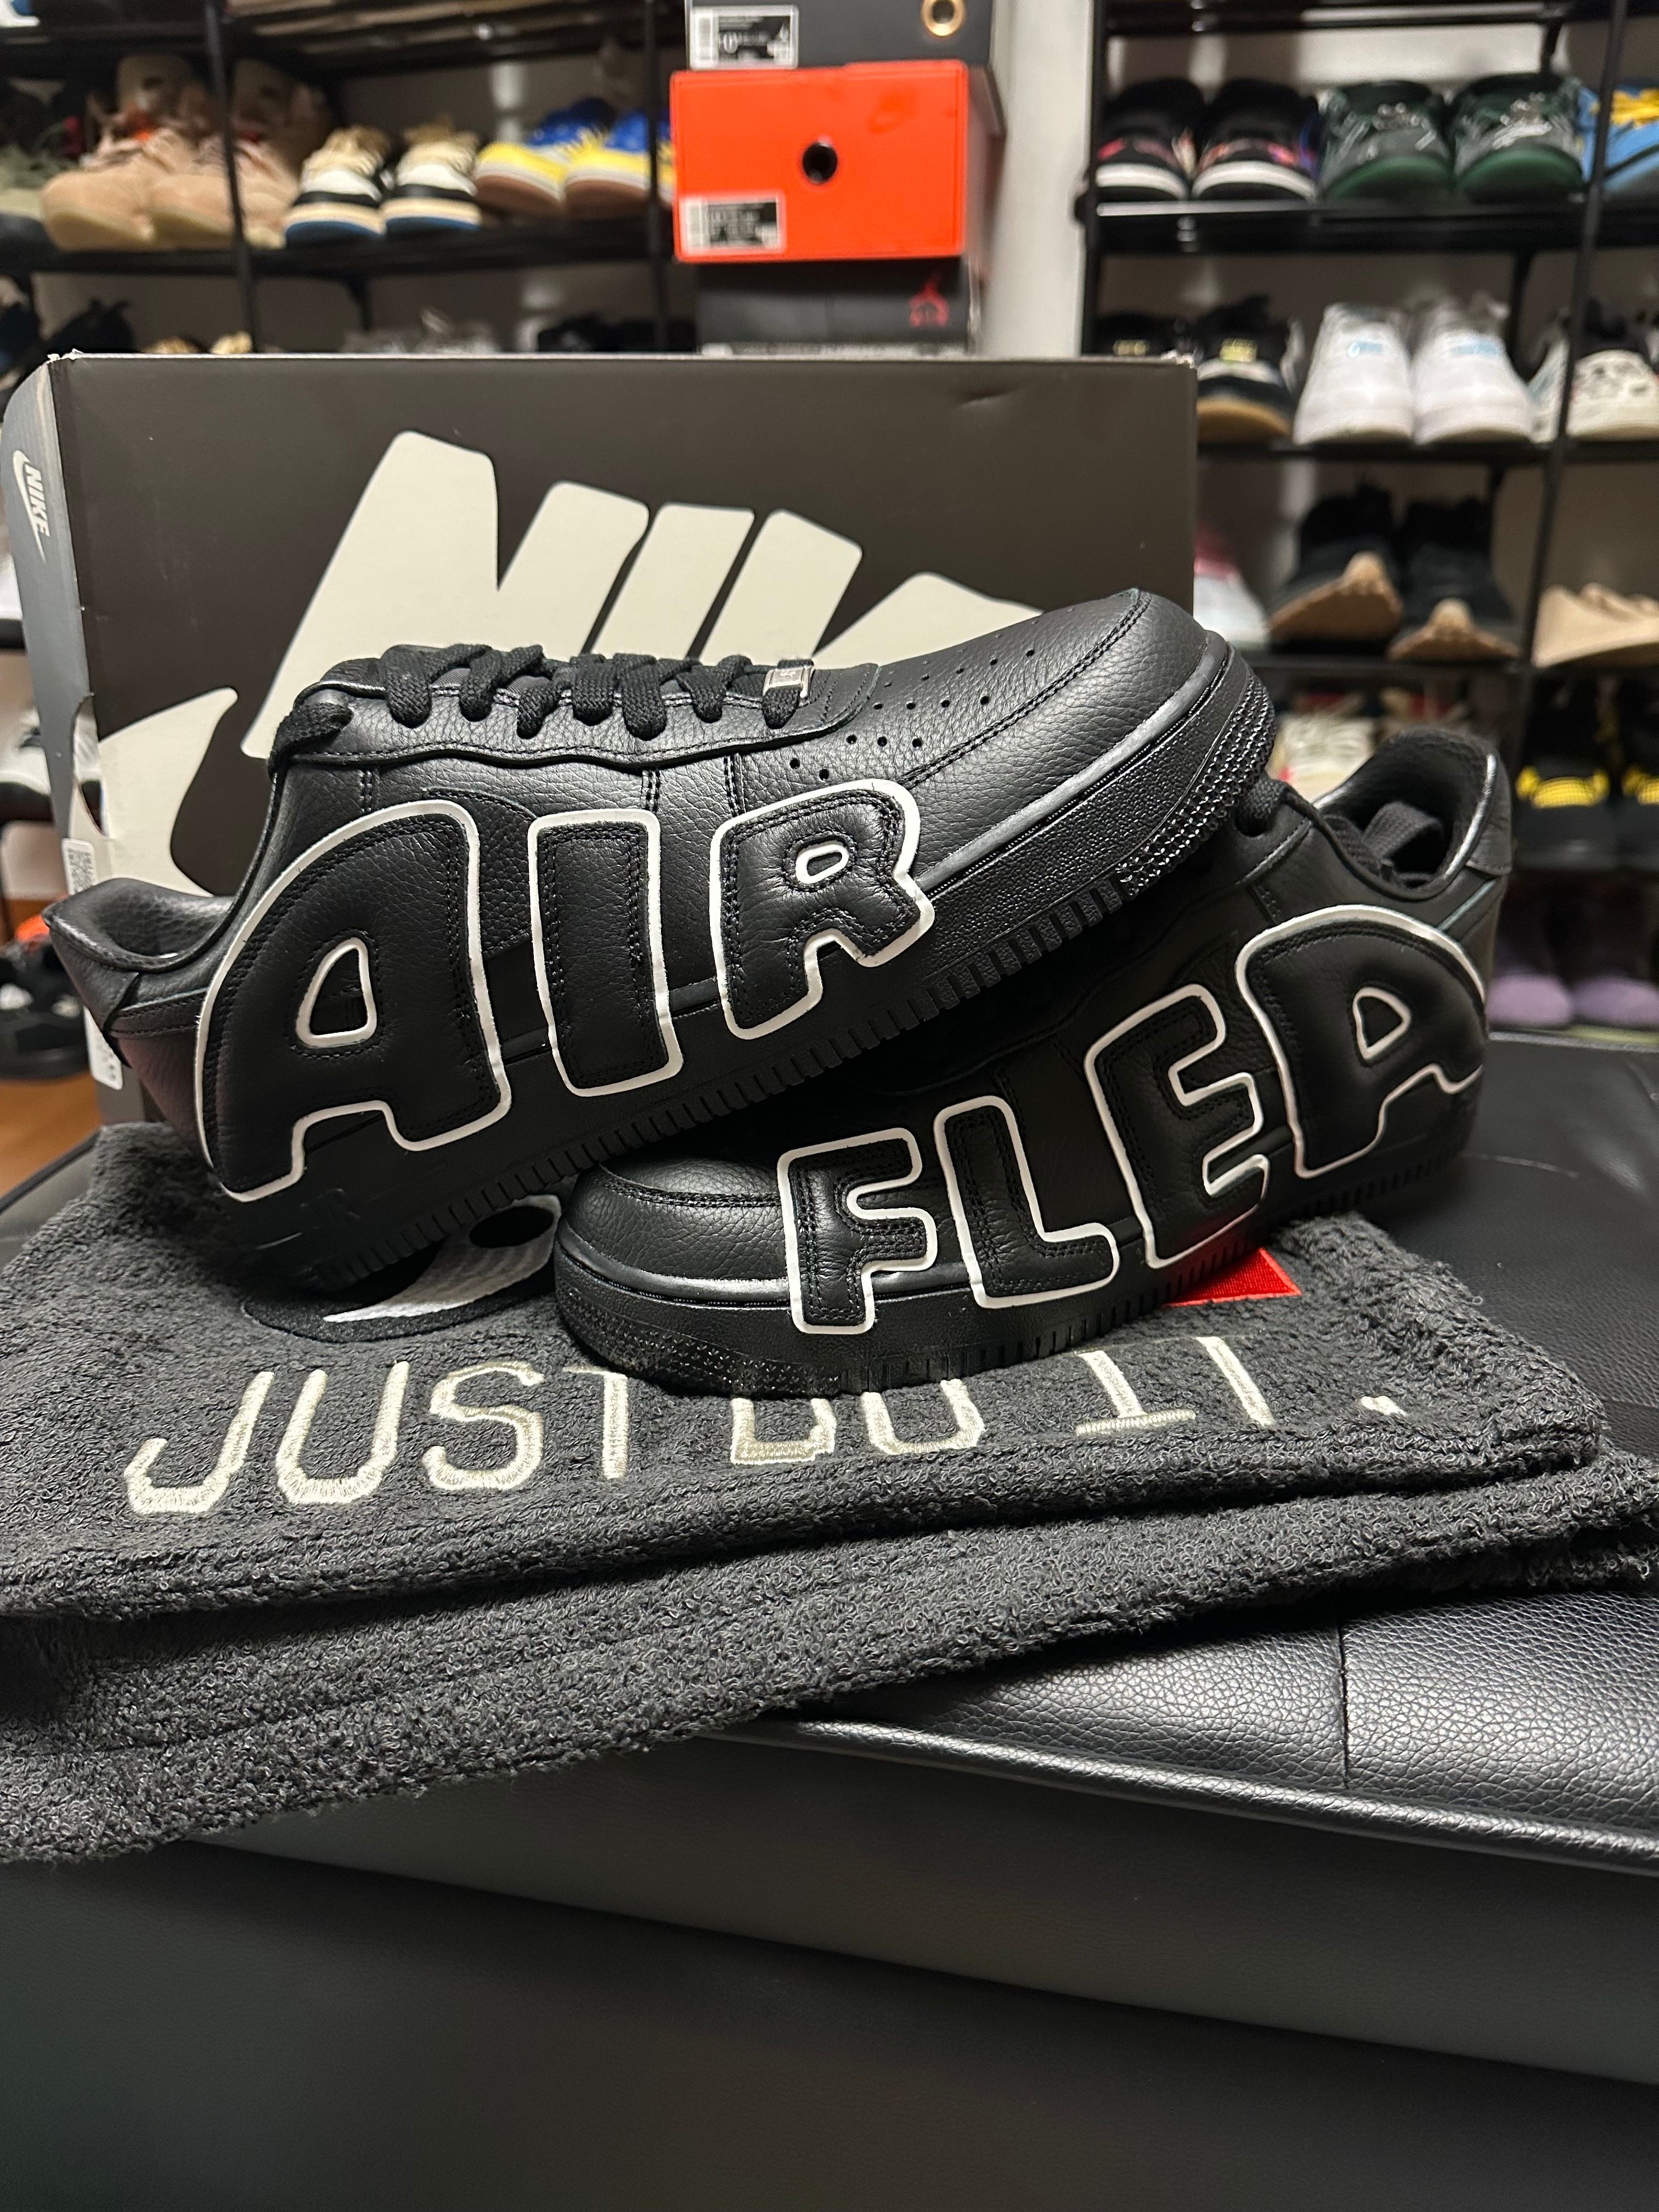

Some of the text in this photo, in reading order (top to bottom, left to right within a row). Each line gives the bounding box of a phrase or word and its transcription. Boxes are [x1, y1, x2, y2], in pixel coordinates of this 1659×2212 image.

[24, 464, 50, 537] NIKE
[240, 430, 1045, 759] NIK
[195, 779, 934, 1202] AIR
[777, 904, 1486, 1334] FLEA
[124, 1361, 629, 1514] JUST
